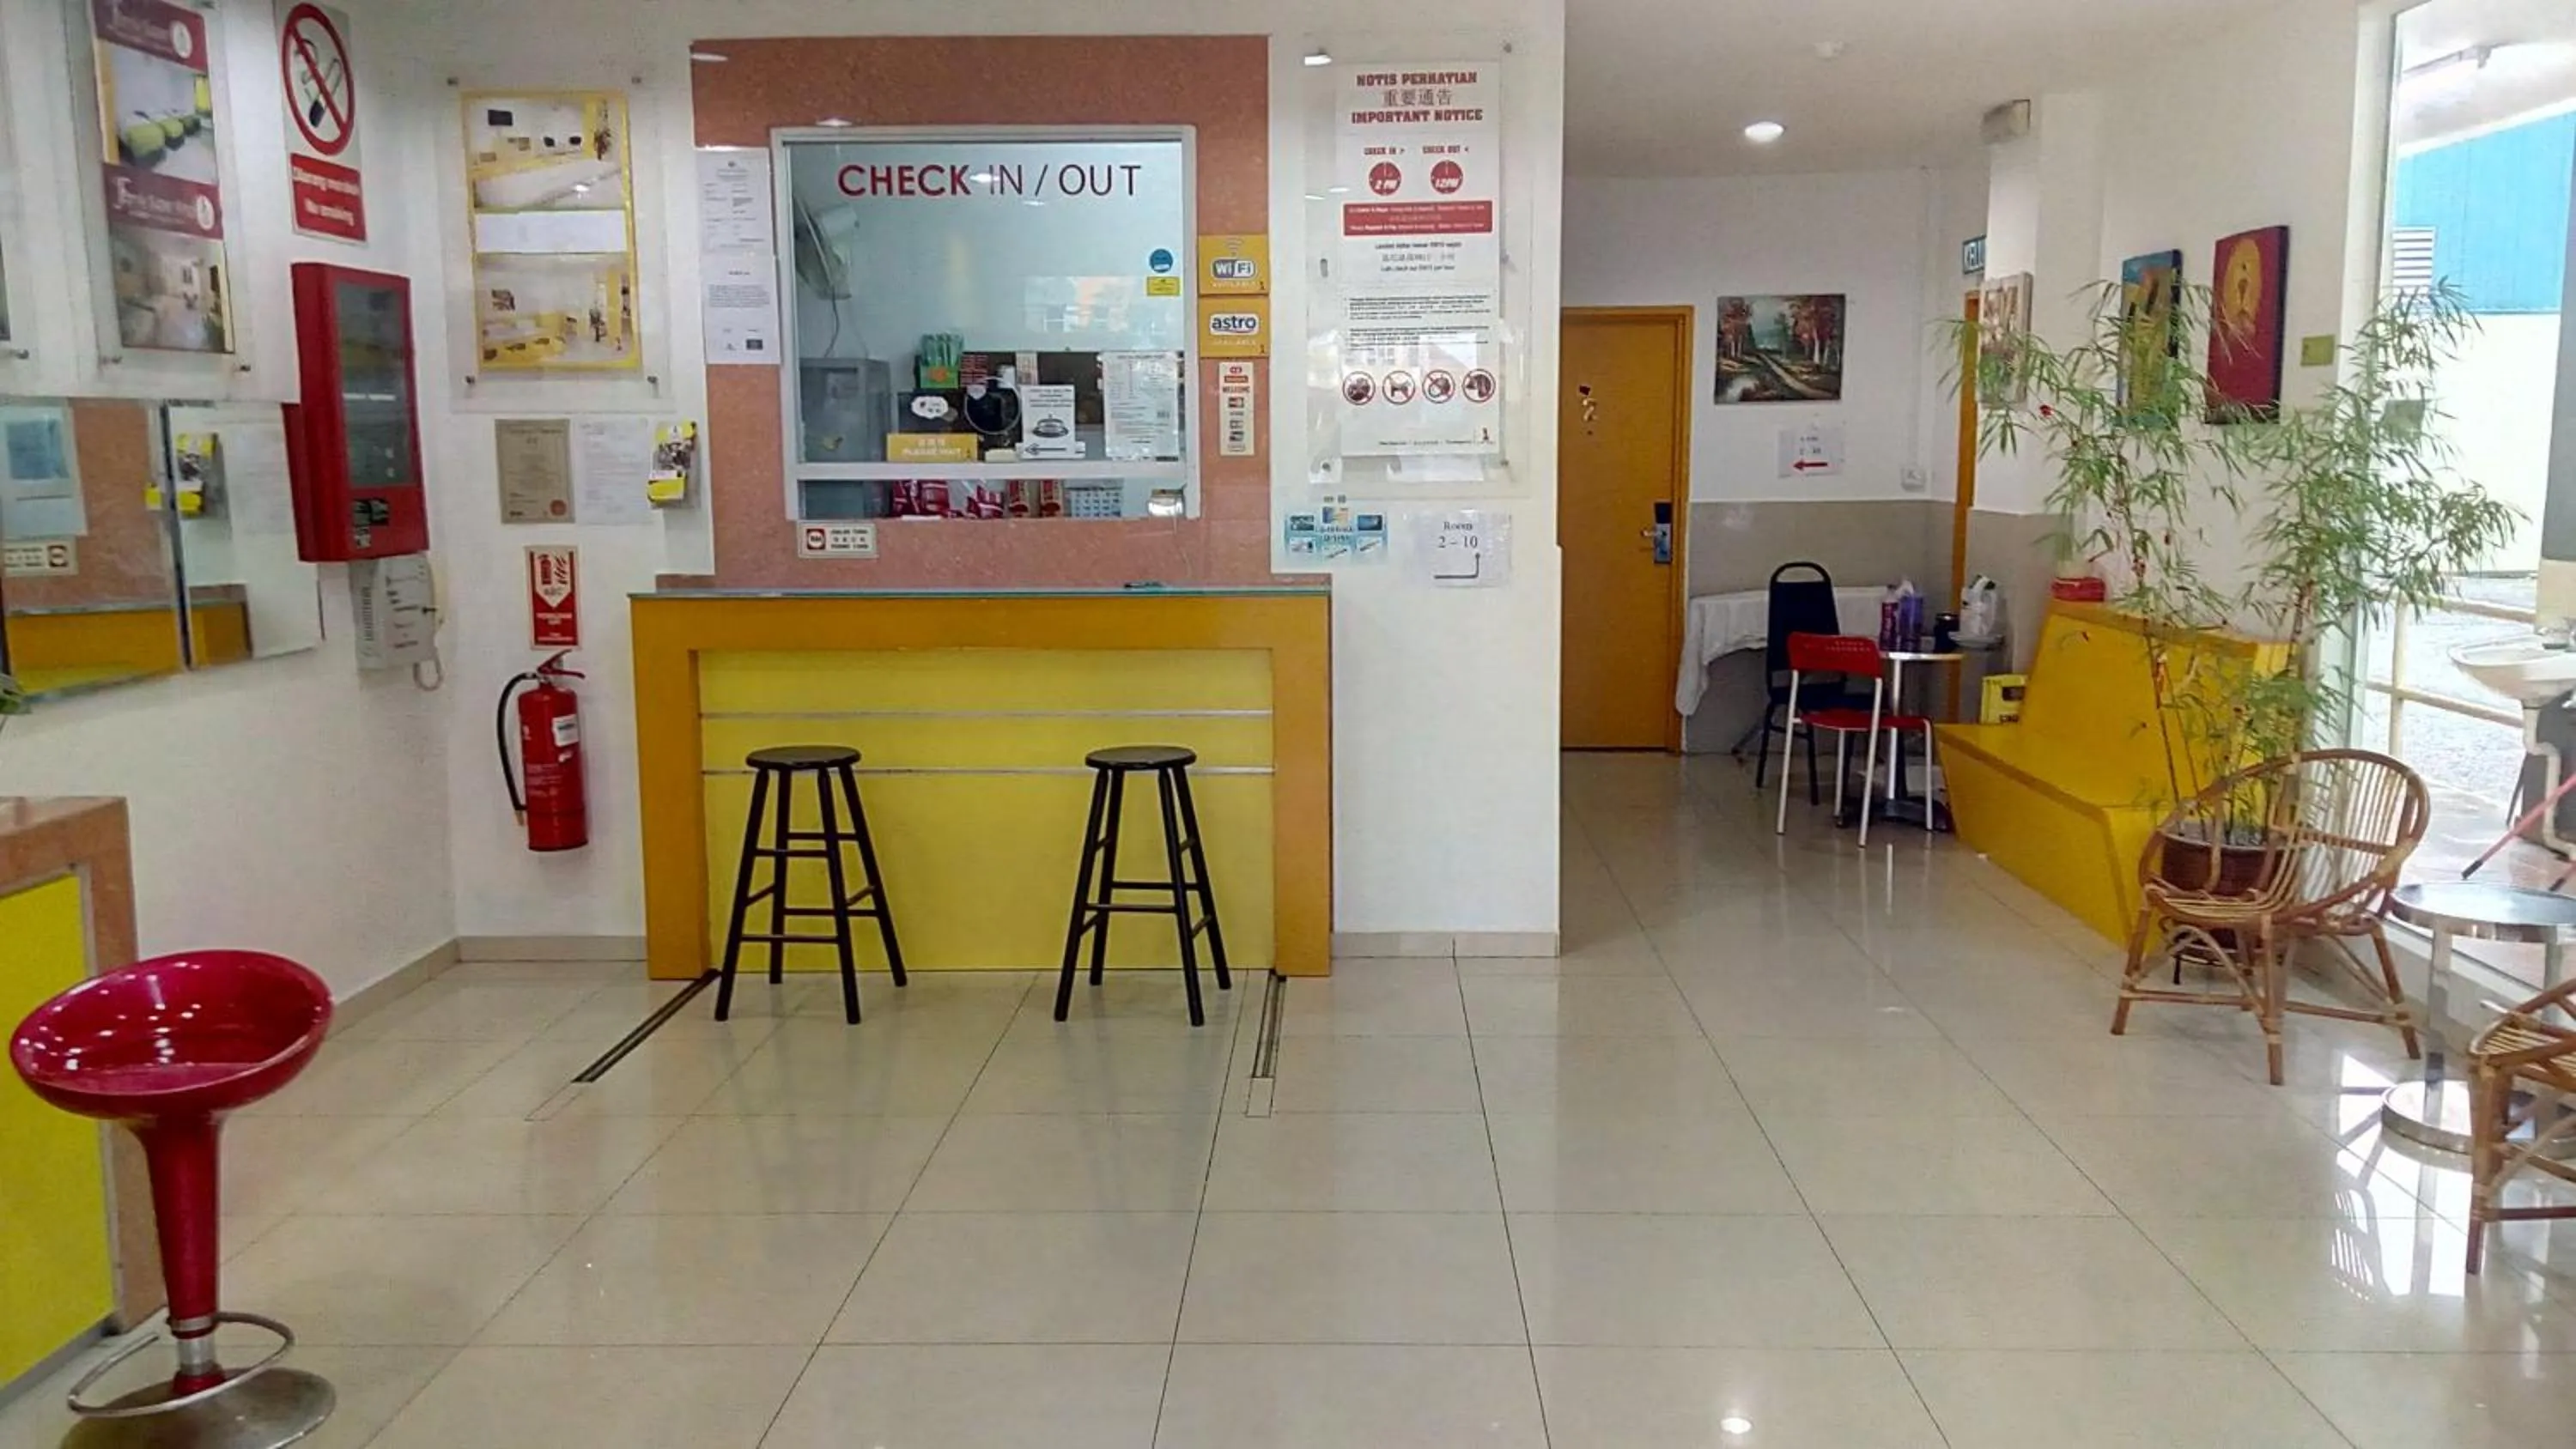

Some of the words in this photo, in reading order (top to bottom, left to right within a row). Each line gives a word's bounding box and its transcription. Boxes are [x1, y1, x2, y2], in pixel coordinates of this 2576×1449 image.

[1357, 74, 1397, 86] NOTIS
[1402, 72, 1477, 85] PERHATIAN
[1352, 111, 1431, 124] IMPORTANT
[1435, 109, 1483, 121] NOTICE
[1422, 145, 1444, 154] CHECK
[838, 164, 972, 197] CHECK
[989, 164, 1023, 196] IN
[1034, 164, 1049, 197] /
[1058, 164, 1142, 197] OUT
[1212, 315, 1257, 329] astro
[1437, 536, 1446, 549] 2
[1463, 536, 1478, 549] 10
